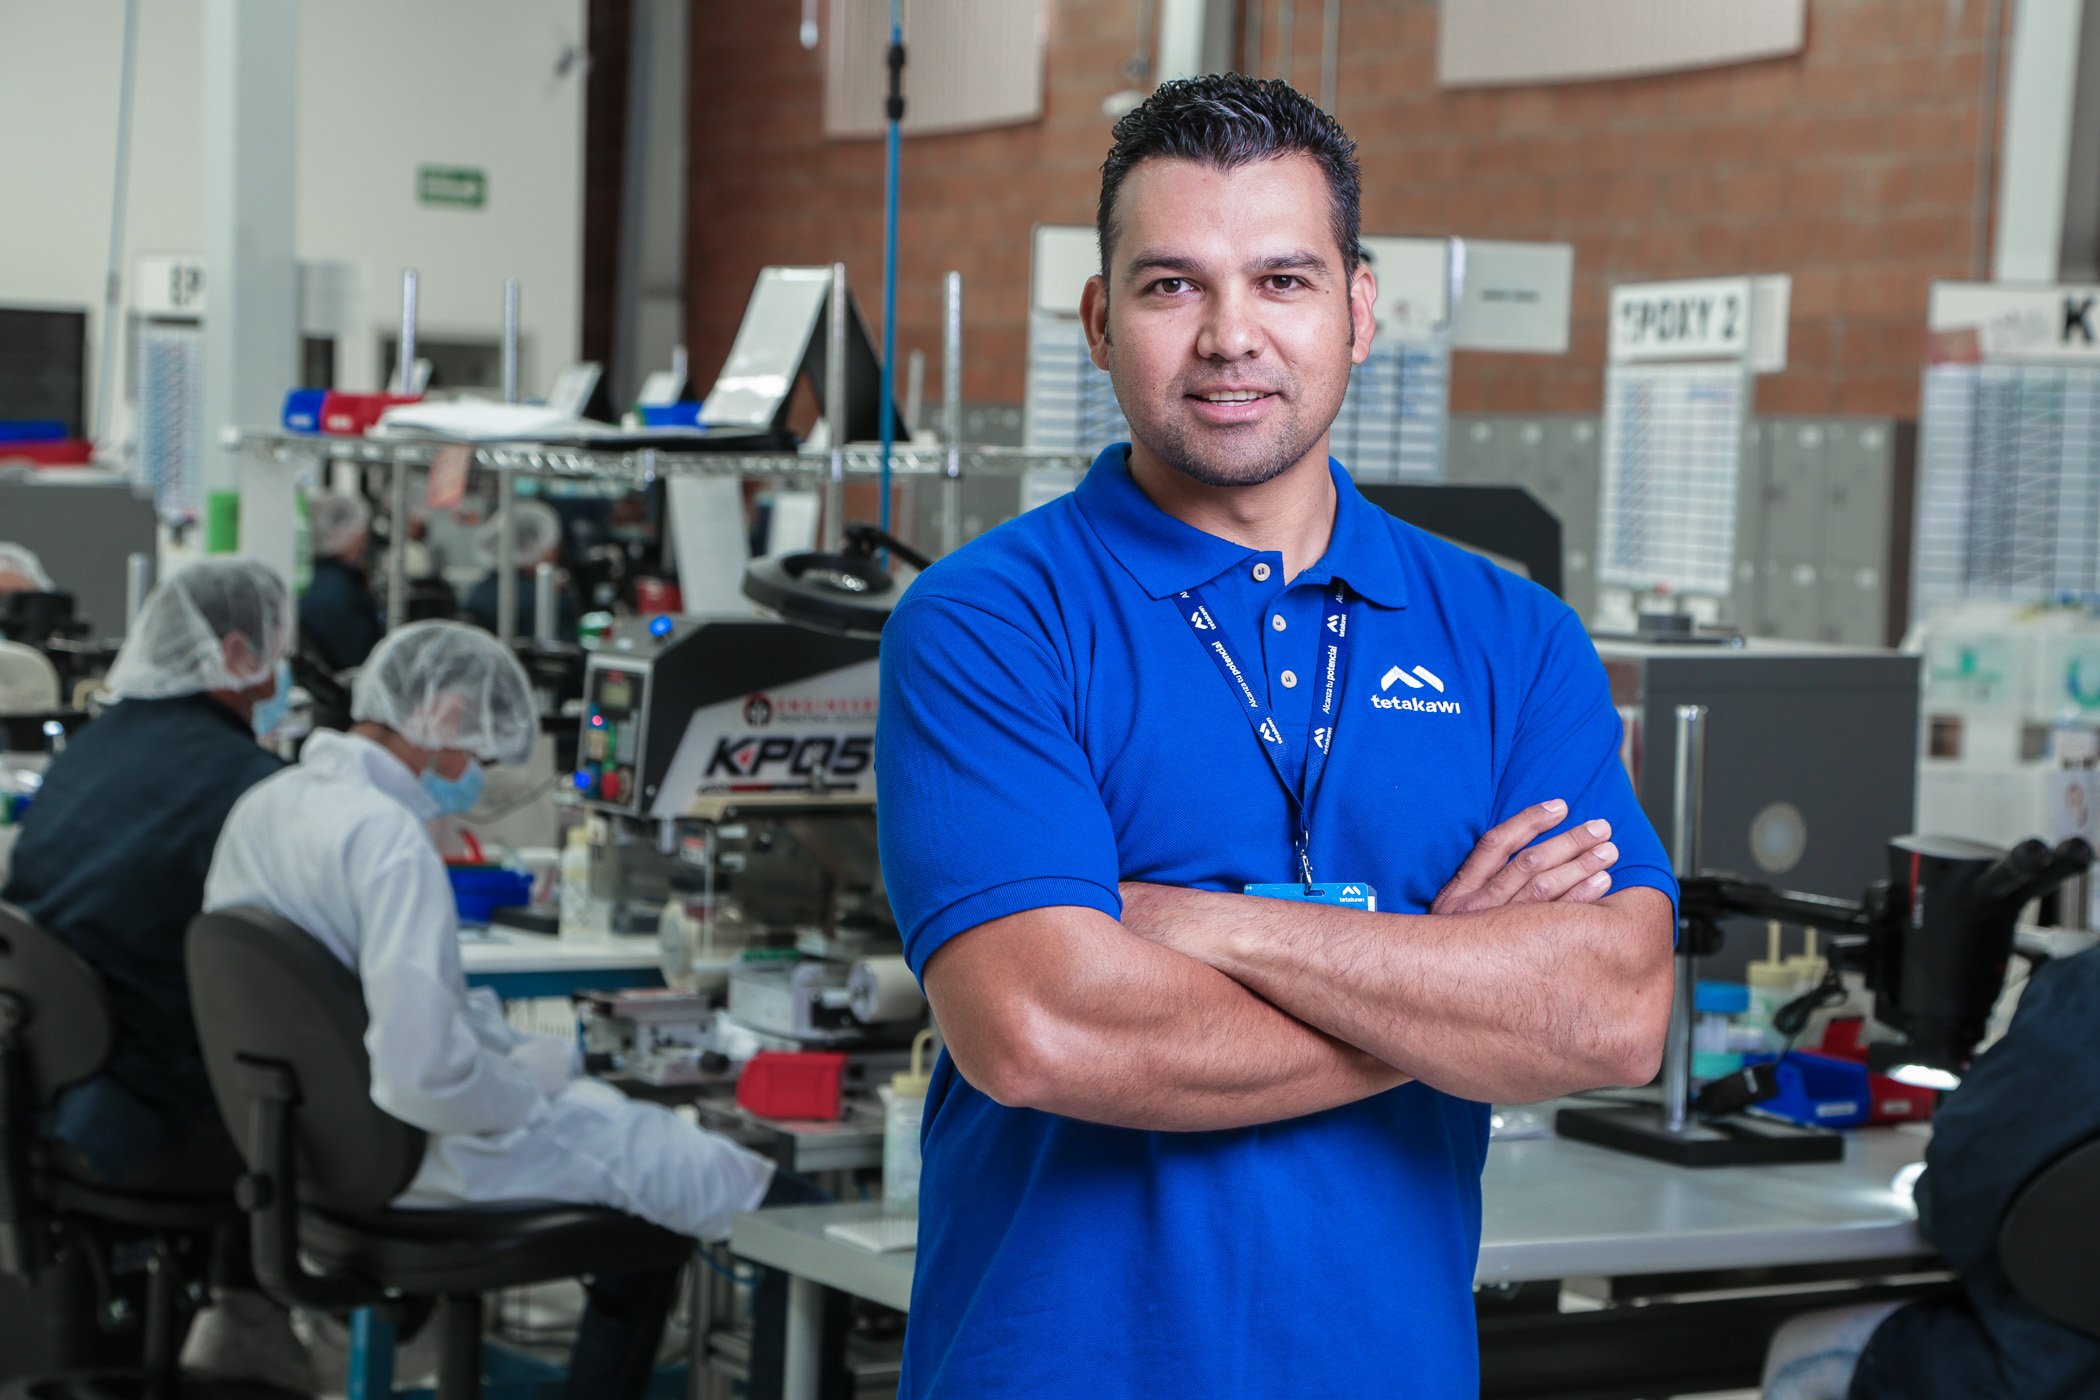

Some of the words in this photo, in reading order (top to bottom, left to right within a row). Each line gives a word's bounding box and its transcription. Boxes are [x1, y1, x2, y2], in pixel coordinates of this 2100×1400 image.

[1211, 640, 1241, 676] potencial
[1327, 645, 1338, 681] potencial
[1235, 675, 1244, 683] tu
[1326, 680, 1334, 688] tu
[1240, 682, 1258, 708] Alcanza
[1322, 688, 1333, 714] Alcanza
[1370, 693, 1461, 715] tetakawi
